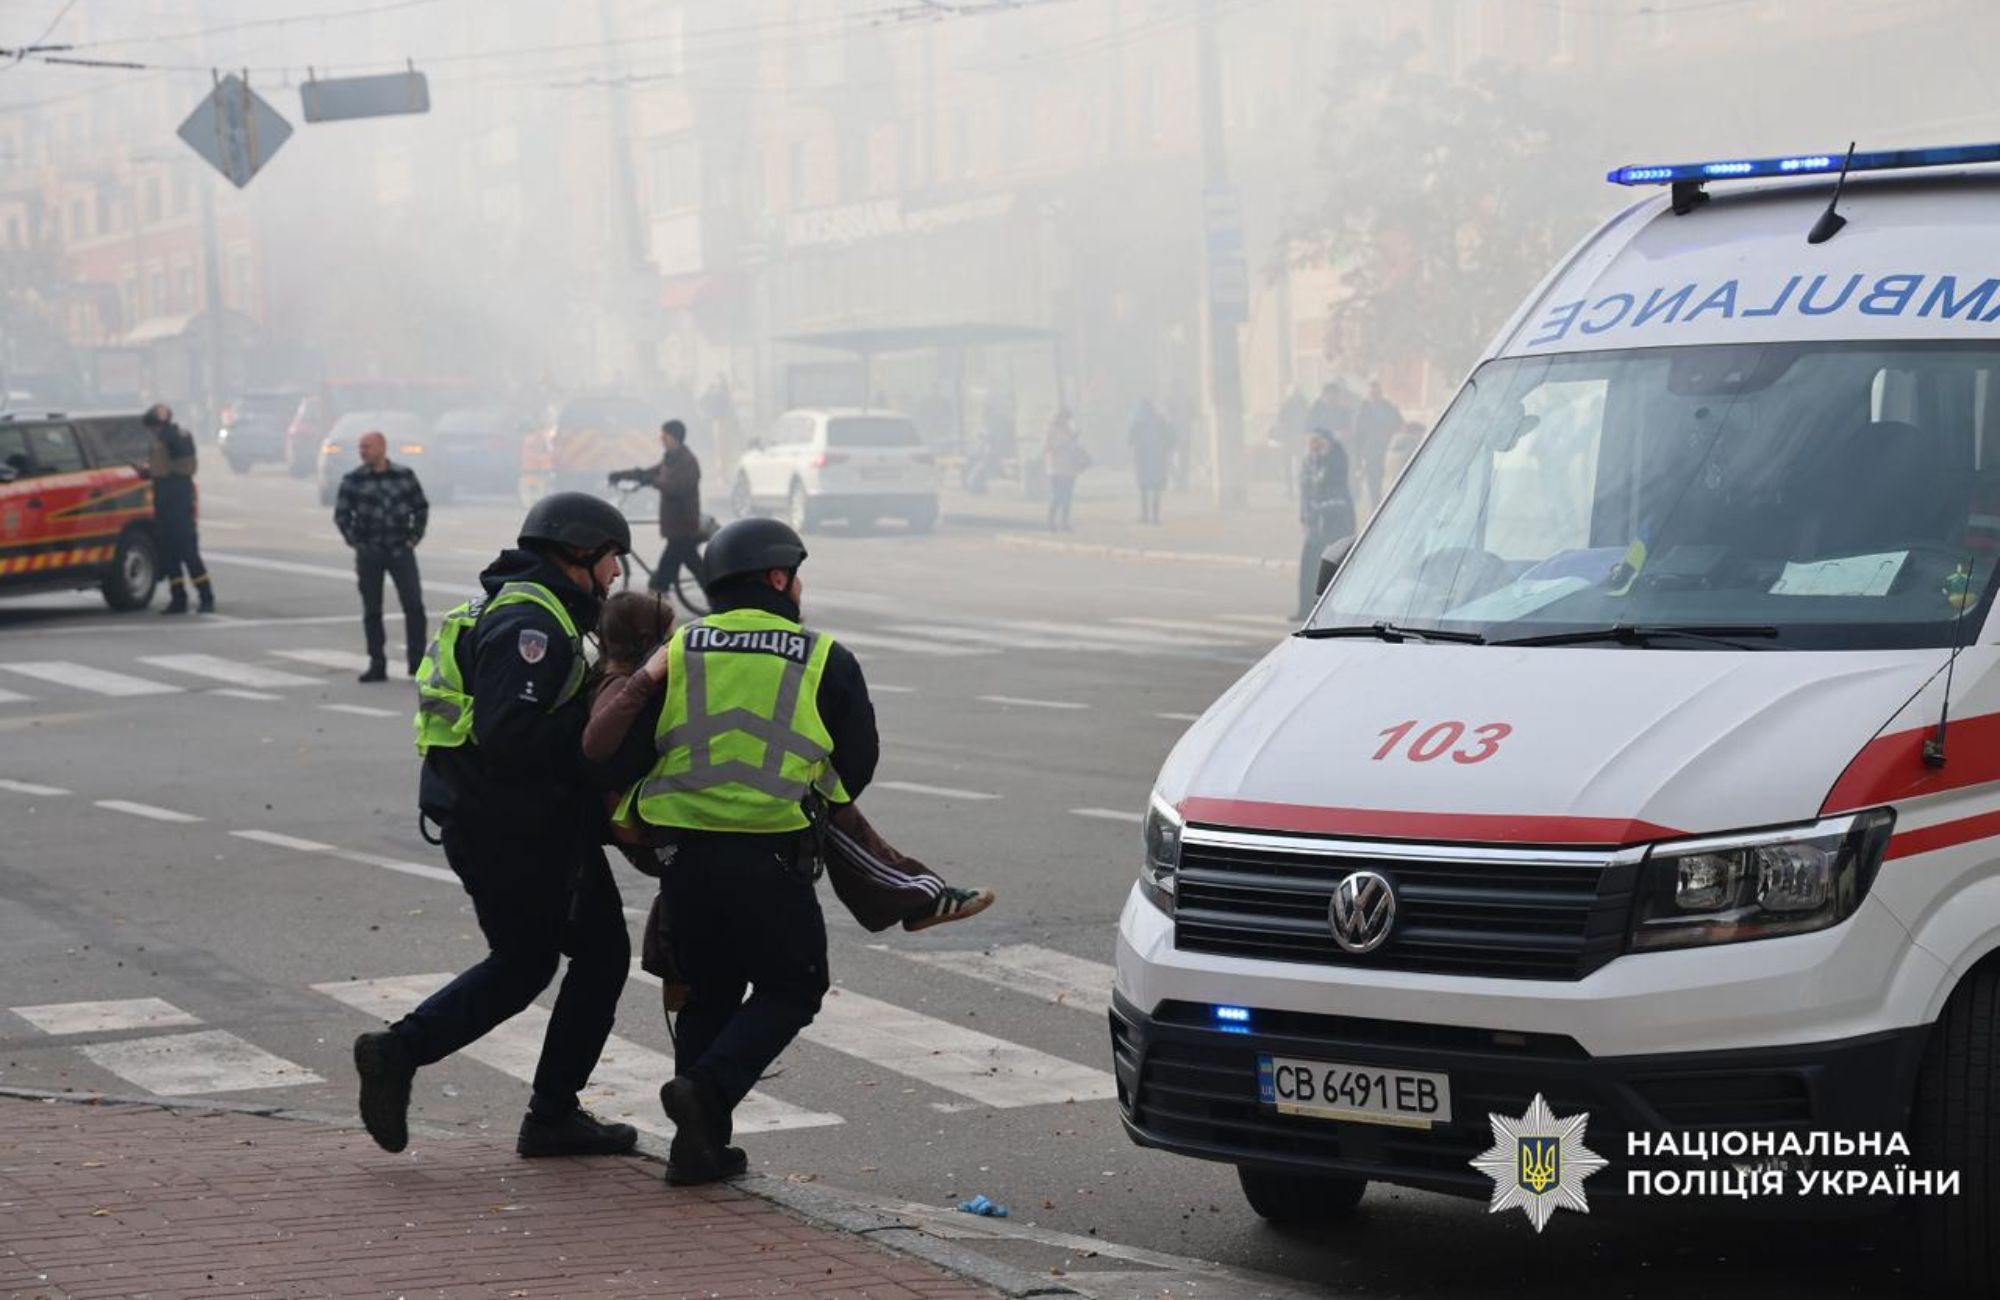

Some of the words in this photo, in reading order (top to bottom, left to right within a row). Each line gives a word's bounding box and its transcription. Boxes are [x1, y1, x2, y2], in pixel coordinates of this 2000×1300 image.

[690, 626, 806, 660] ПОЛІЦІЯ
[1371, 719, 1513, 765] 103
[1322, 1069, 1388, 1110] 6491
